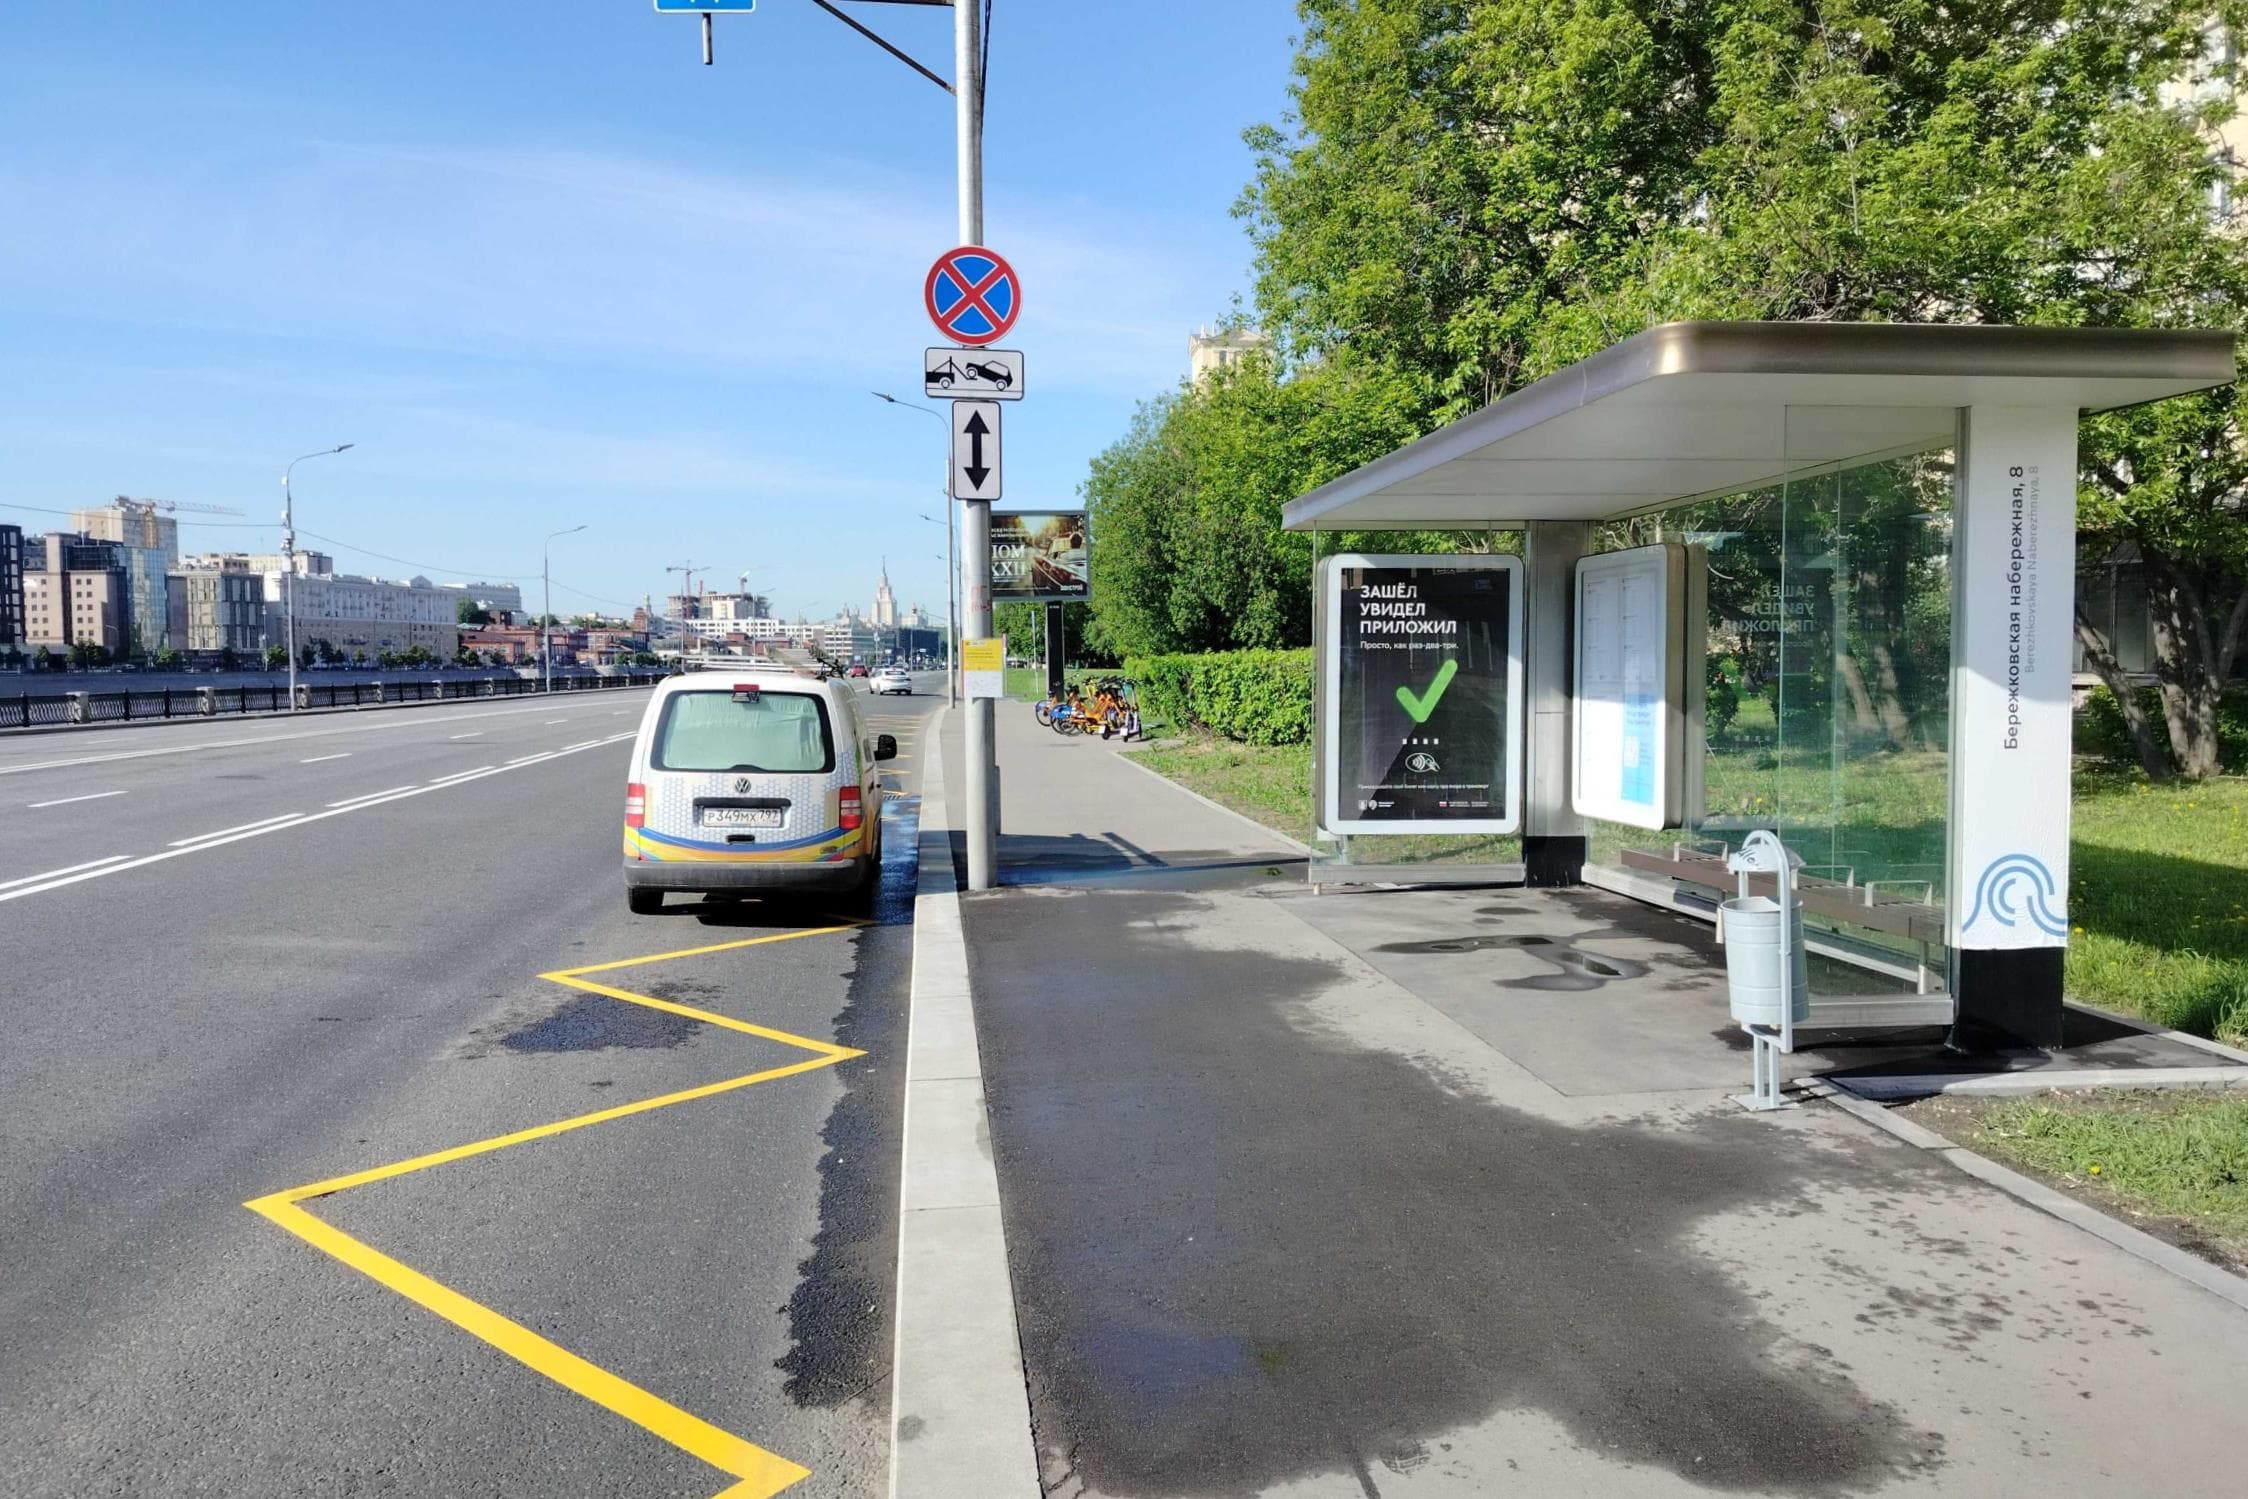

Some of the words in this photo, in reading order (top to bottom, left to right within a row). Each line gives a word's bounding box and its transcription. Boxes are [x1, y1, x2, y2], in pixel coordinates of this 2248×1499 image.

[2009, 466, 2024, 478] 8
[2028, 465, 2039, 474] 8
[2006, 483, 2026, 605] набережная,
[1360, 582, 1417, 598] ЗАШЁЛ
[1360, 603, 1426, 618] УВИДЕЛ
[1360, 620, 1457, 634] ПРИЛОЖИЛ
[2024, 573, 2038, 673] Berezhkovskaya
[1360, 640, 1392, 651] Просто,
[1408, 642, 1459, 651] раз-два-три.
[2004, 612, 2022, 749] Бережковская
